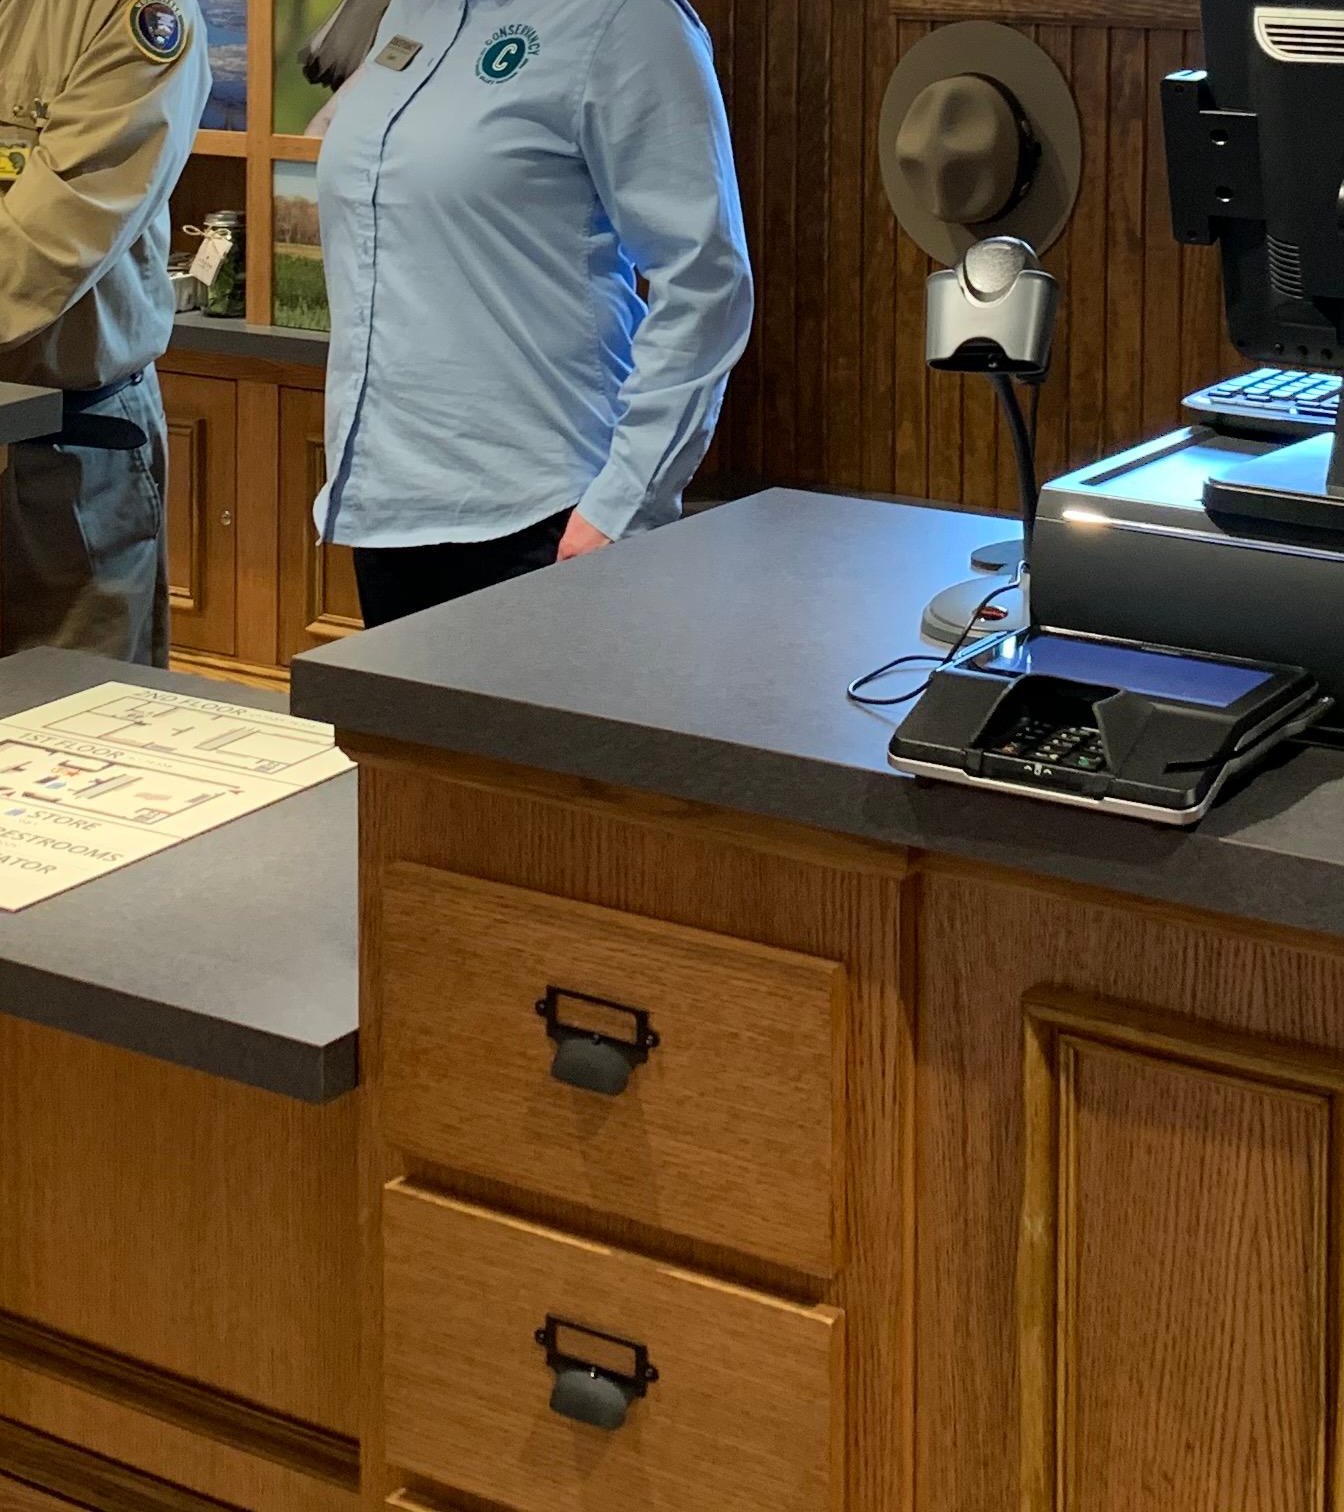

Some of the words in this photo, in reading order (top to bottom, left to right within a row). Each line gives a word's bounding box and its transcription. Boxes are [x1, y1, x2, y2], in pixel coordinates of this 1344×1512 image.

[484, 24, 541, 56] CONSERVANCY
[132, 688, 183, 706] 2ND
[183, 696, 248, 717] FLOOR
[20, 732, 58, 745] 1ST
[55, 737, 126, 760] FLOOR
[26, 810, 104, 833] STORE
